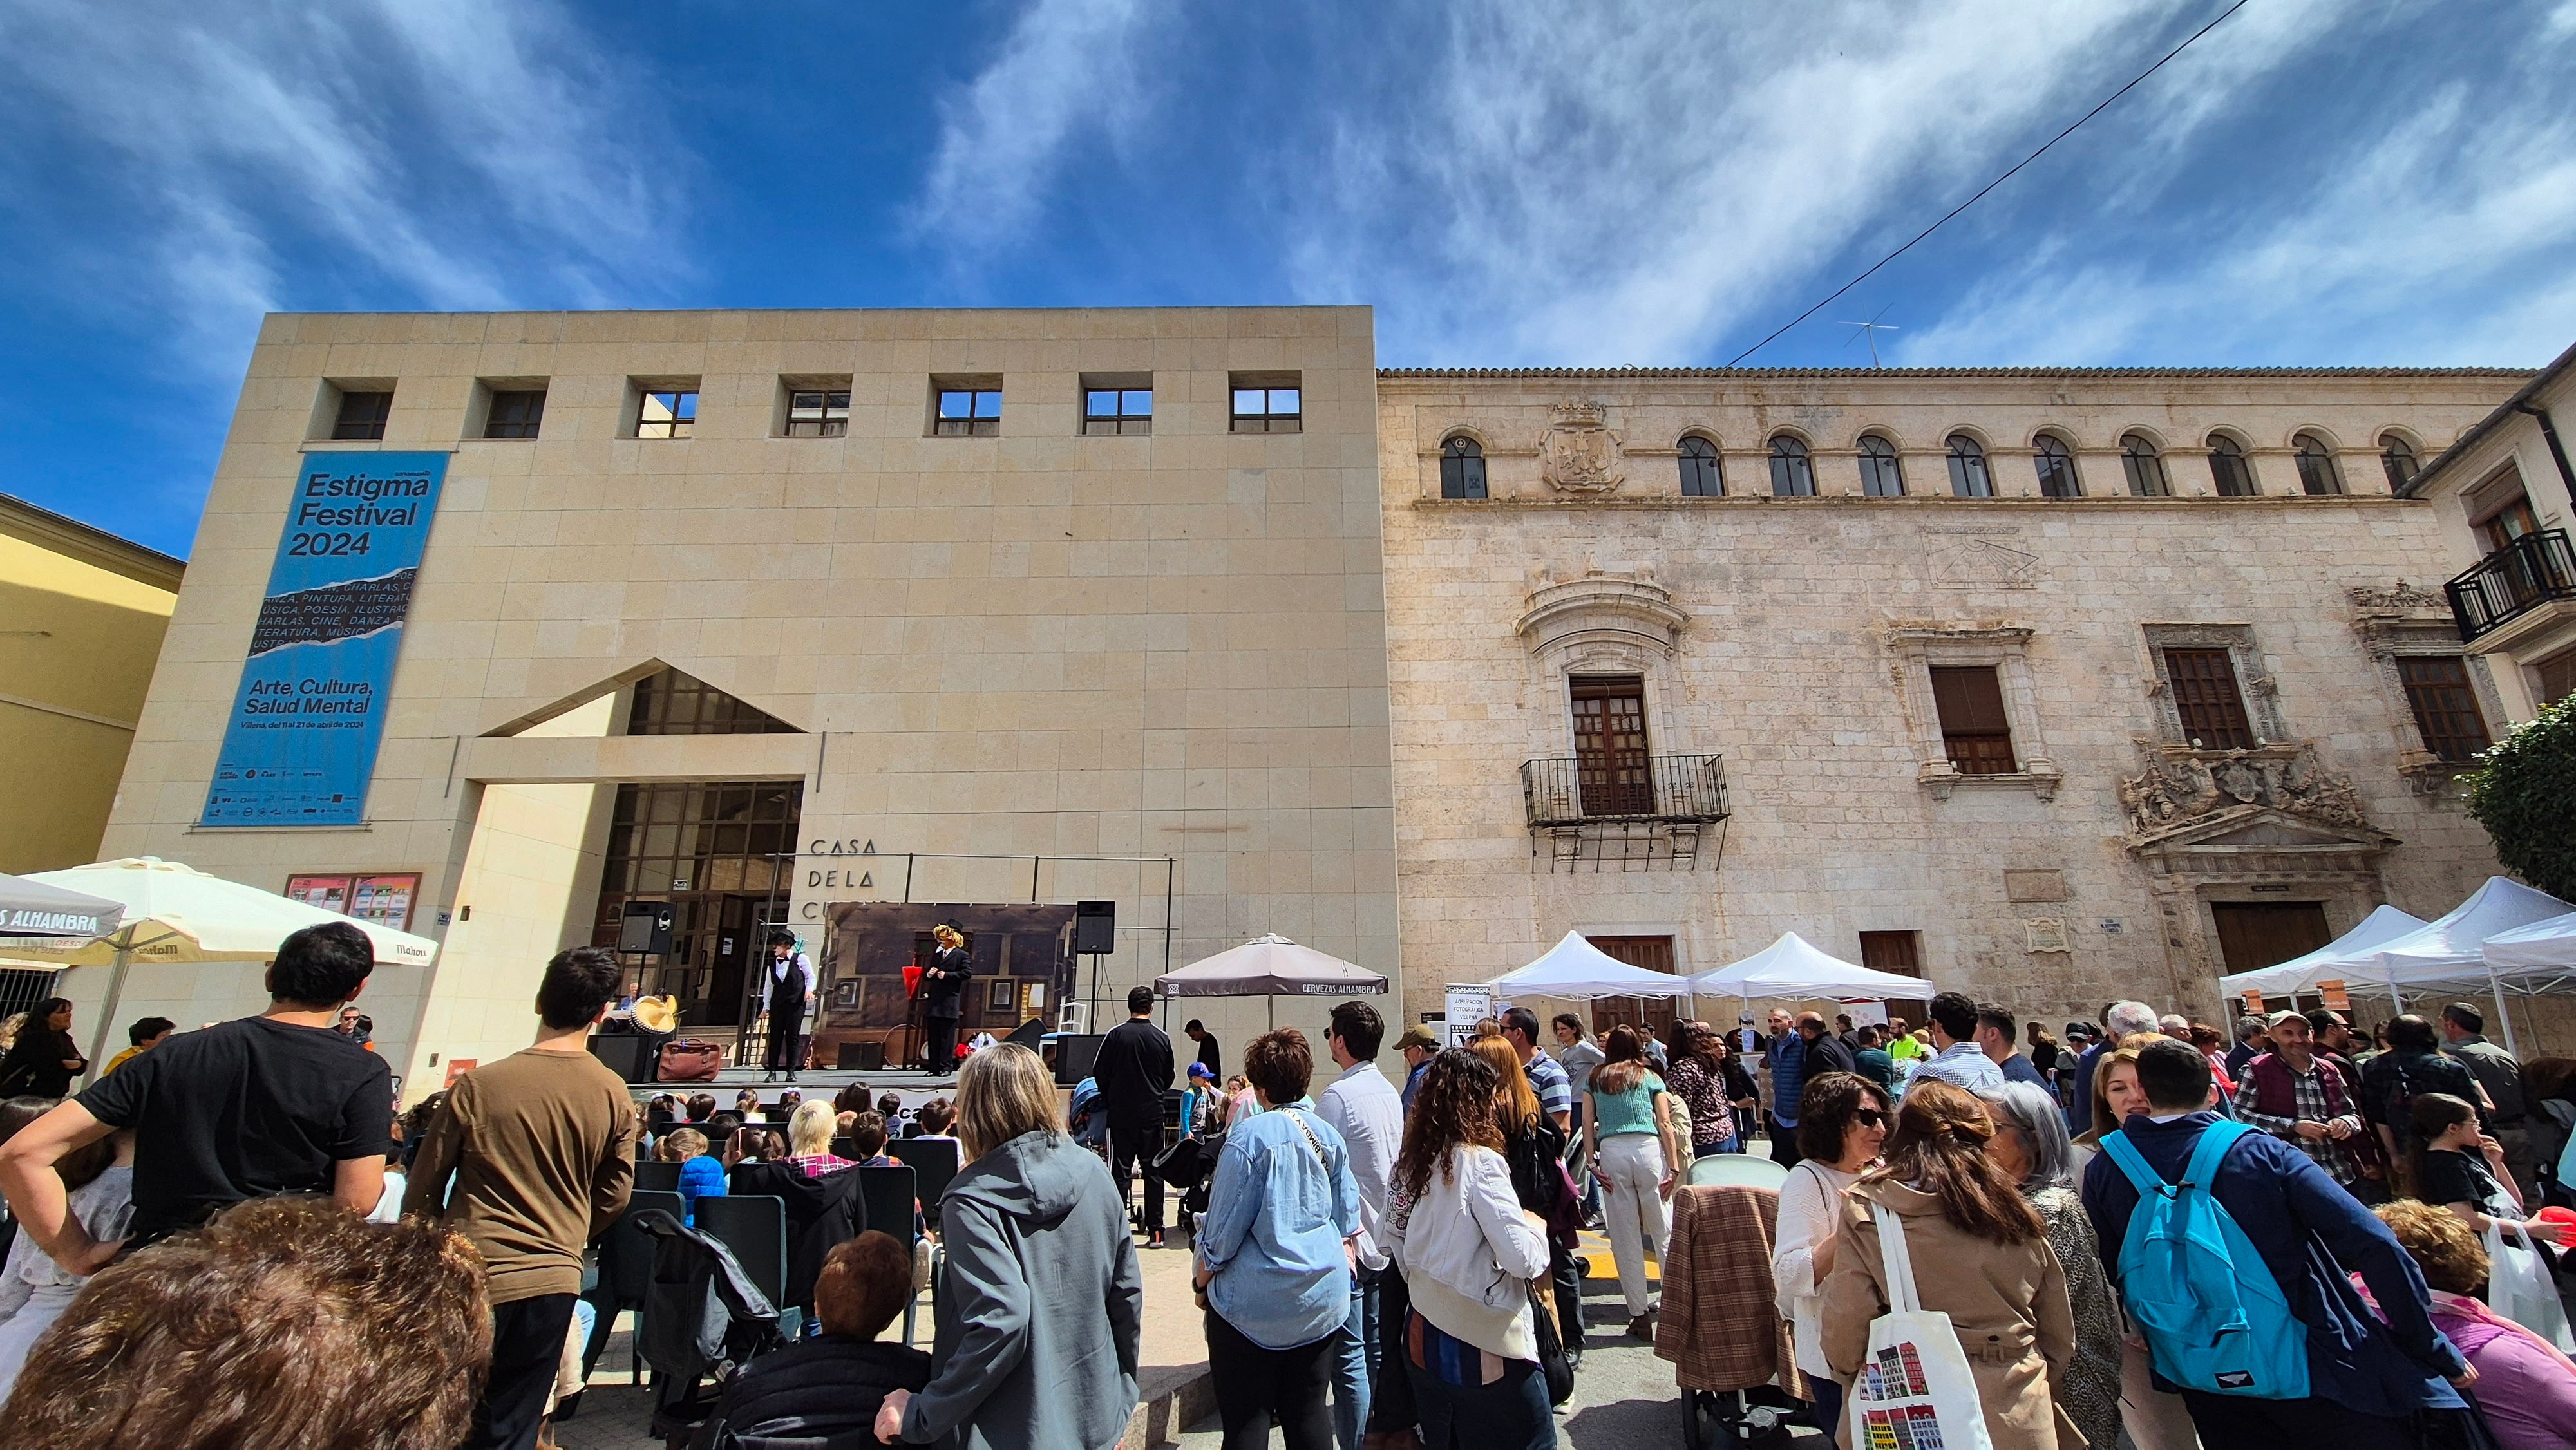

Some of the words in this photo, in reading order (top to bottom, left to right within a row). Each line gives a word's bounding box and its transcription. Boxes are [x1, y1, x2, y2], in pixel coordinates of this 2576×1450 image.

[305, 473, 430, 501] Estigma
[297, 502, 417, 526] Festival
[288, 532, 370, 556] 2024
[301, 594, 354, 603] PINTURA,
[303, 604, 350, 614] POESÍA,
[311, 617, 342, 626] CINE,
[249, 679, 294, 697] Arte,
[299, 679, 373, 696] Cultura,
[244, 697, 301, 714] Salud
[303, 698, 370, 713] Mental
[810, 839, 876, 854] CASA
[10, 910, 97, 932] ALHAMBRA
[396, 945, 427, 956] Mahou
[1302, 984, 1336, 993] CERVEZAS
[1338, 984, 1376, 994] ALHAMBRA
[1302, 1123, 1321, 1154] BIMBA
